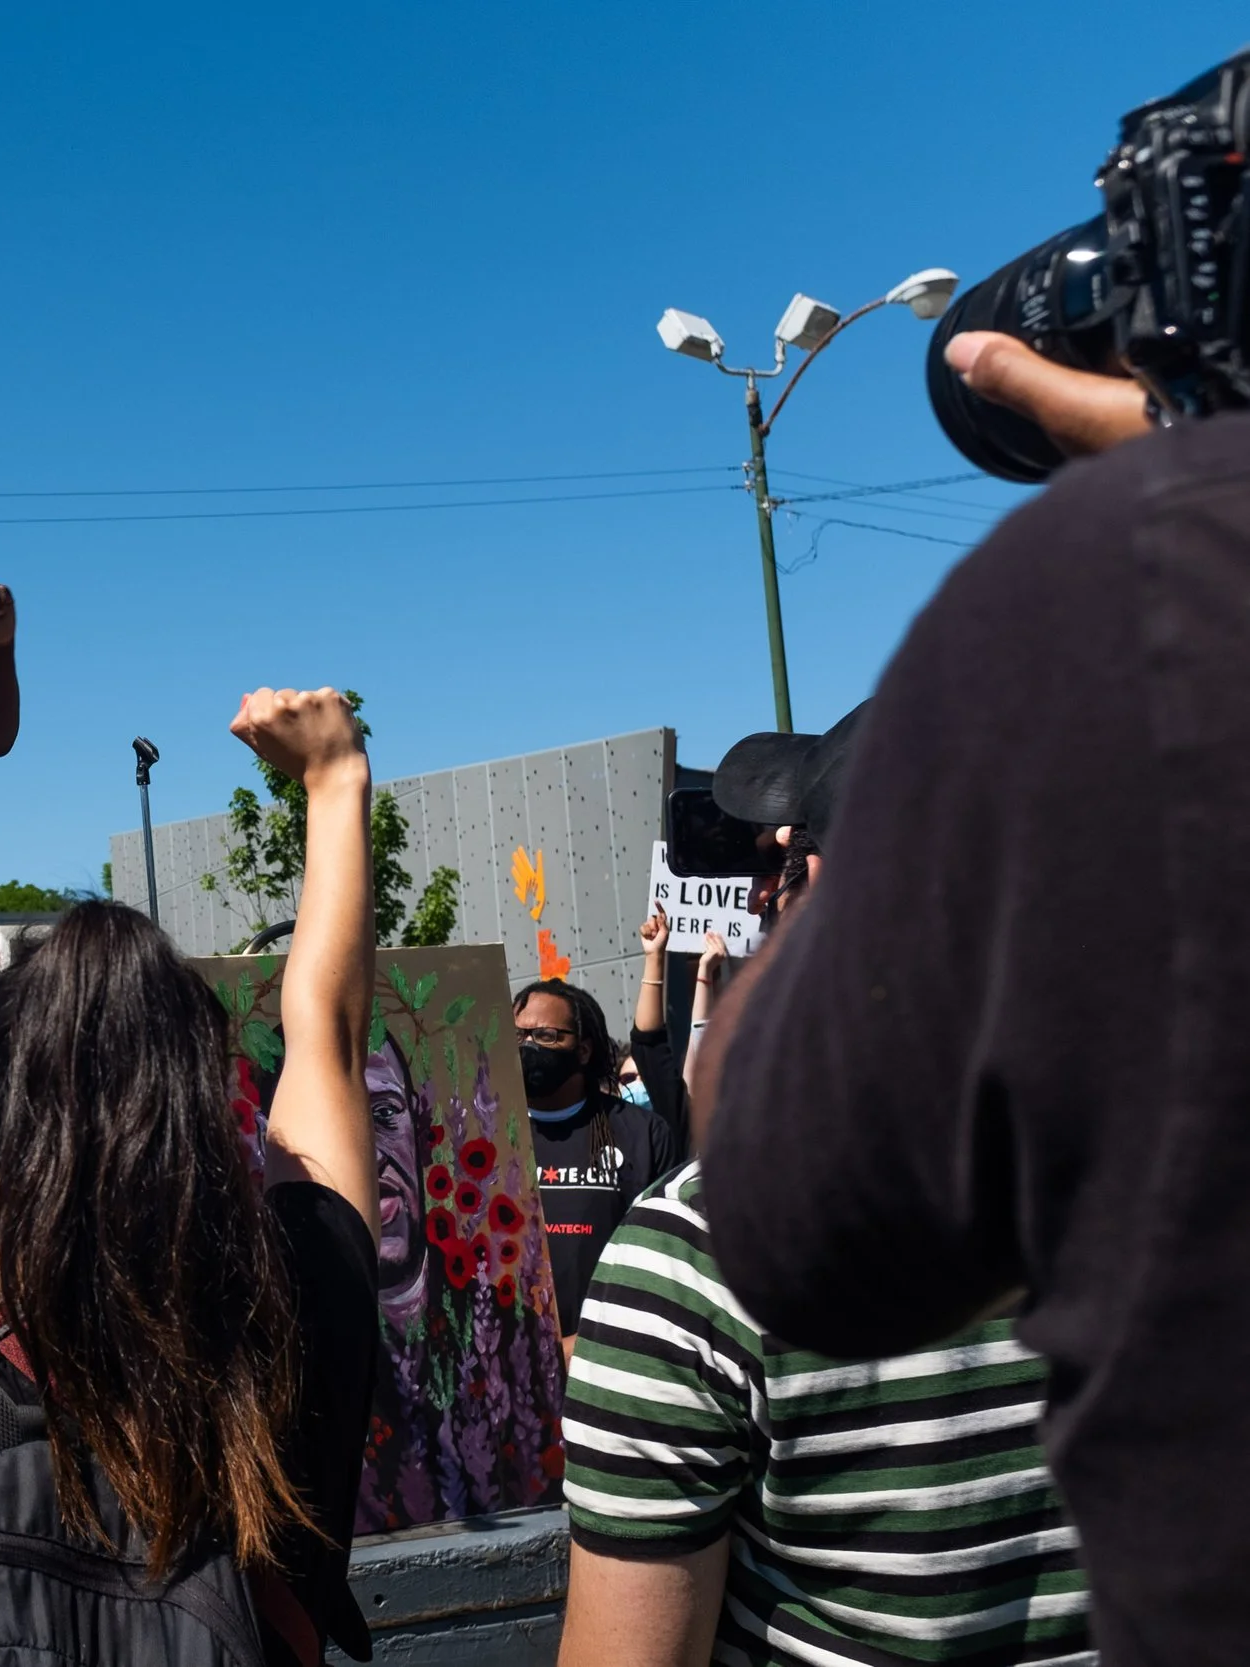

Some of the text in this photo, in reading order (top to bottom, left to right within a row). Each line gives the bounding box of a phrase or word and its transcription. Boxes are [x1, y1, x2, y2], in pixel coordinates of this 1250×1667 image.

[655, 881, 748, 910] IS LOVE
[728, 921, 742, 937] IS
